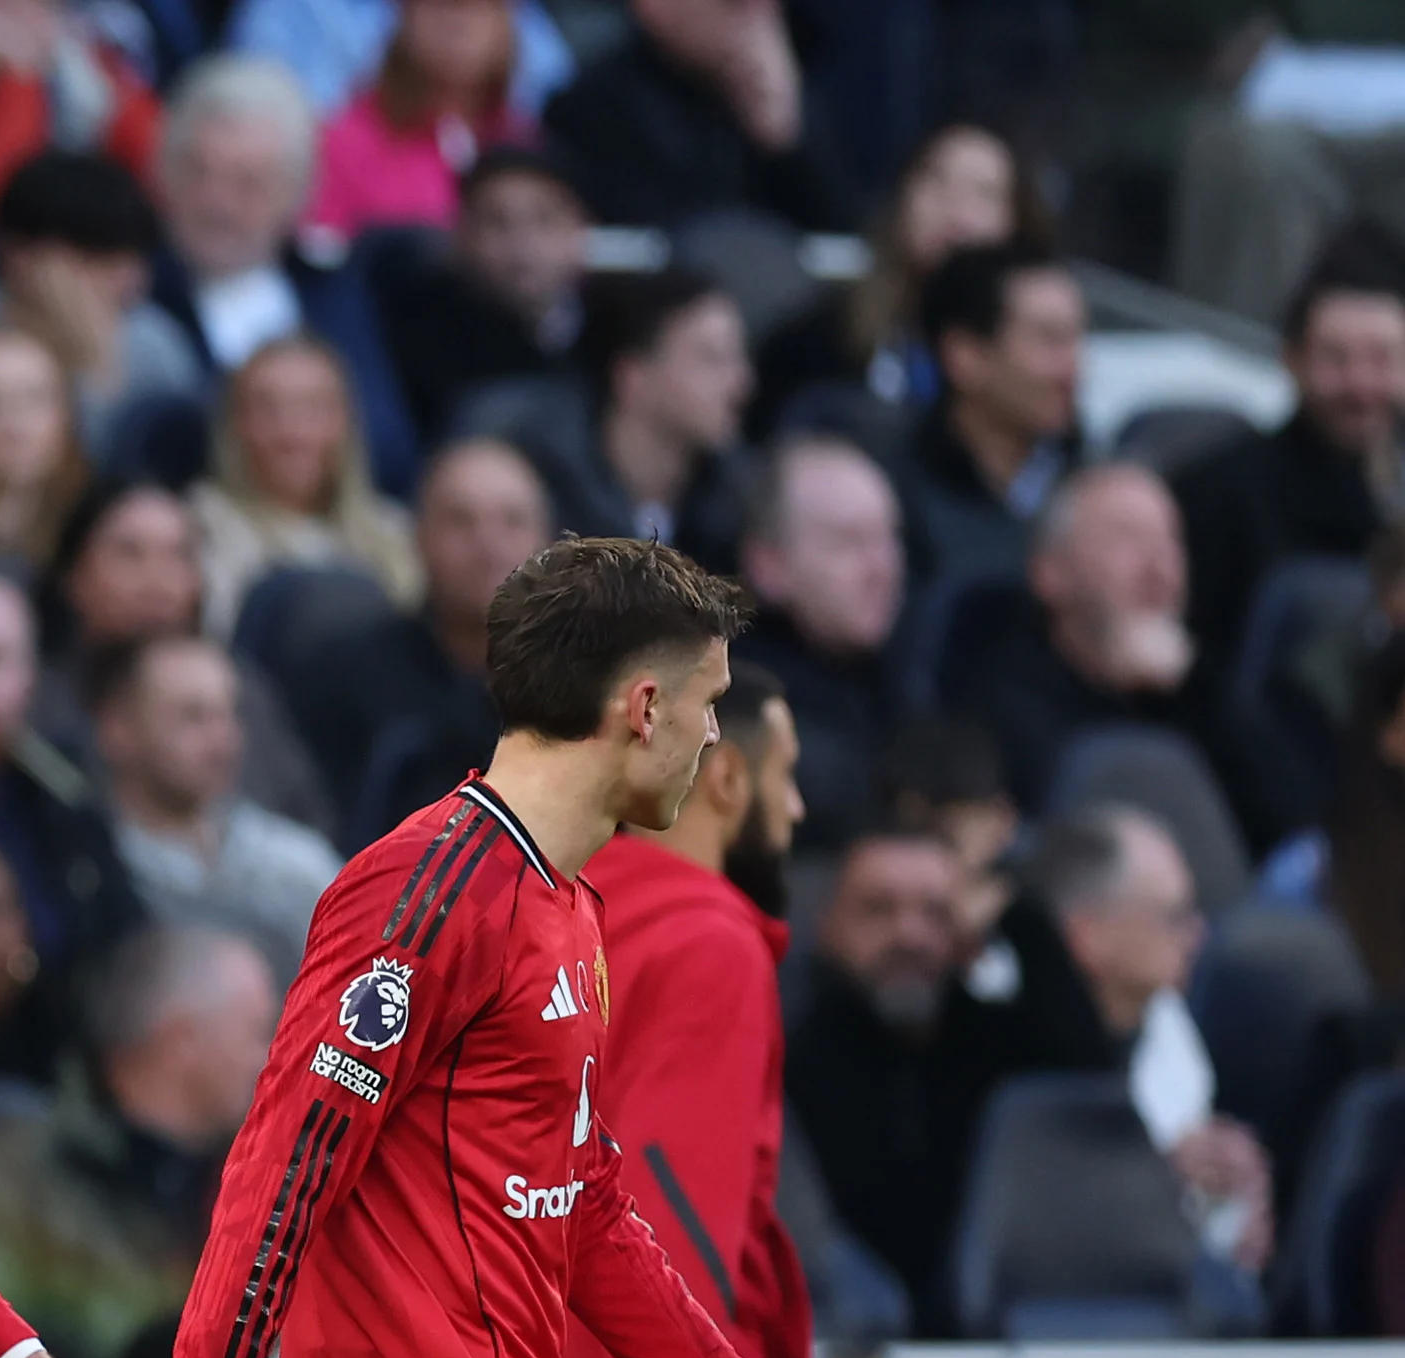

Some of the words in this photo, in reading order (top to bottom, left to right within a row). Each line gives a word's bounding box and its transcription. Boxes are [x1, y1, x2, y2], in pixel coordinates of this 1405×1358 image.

[310, 1057, 335, 1080] for
[334, 1071, 381, 1104] racism
[318, 1042, 341, 1064] No
[343, 1056, 381, 1087] room
